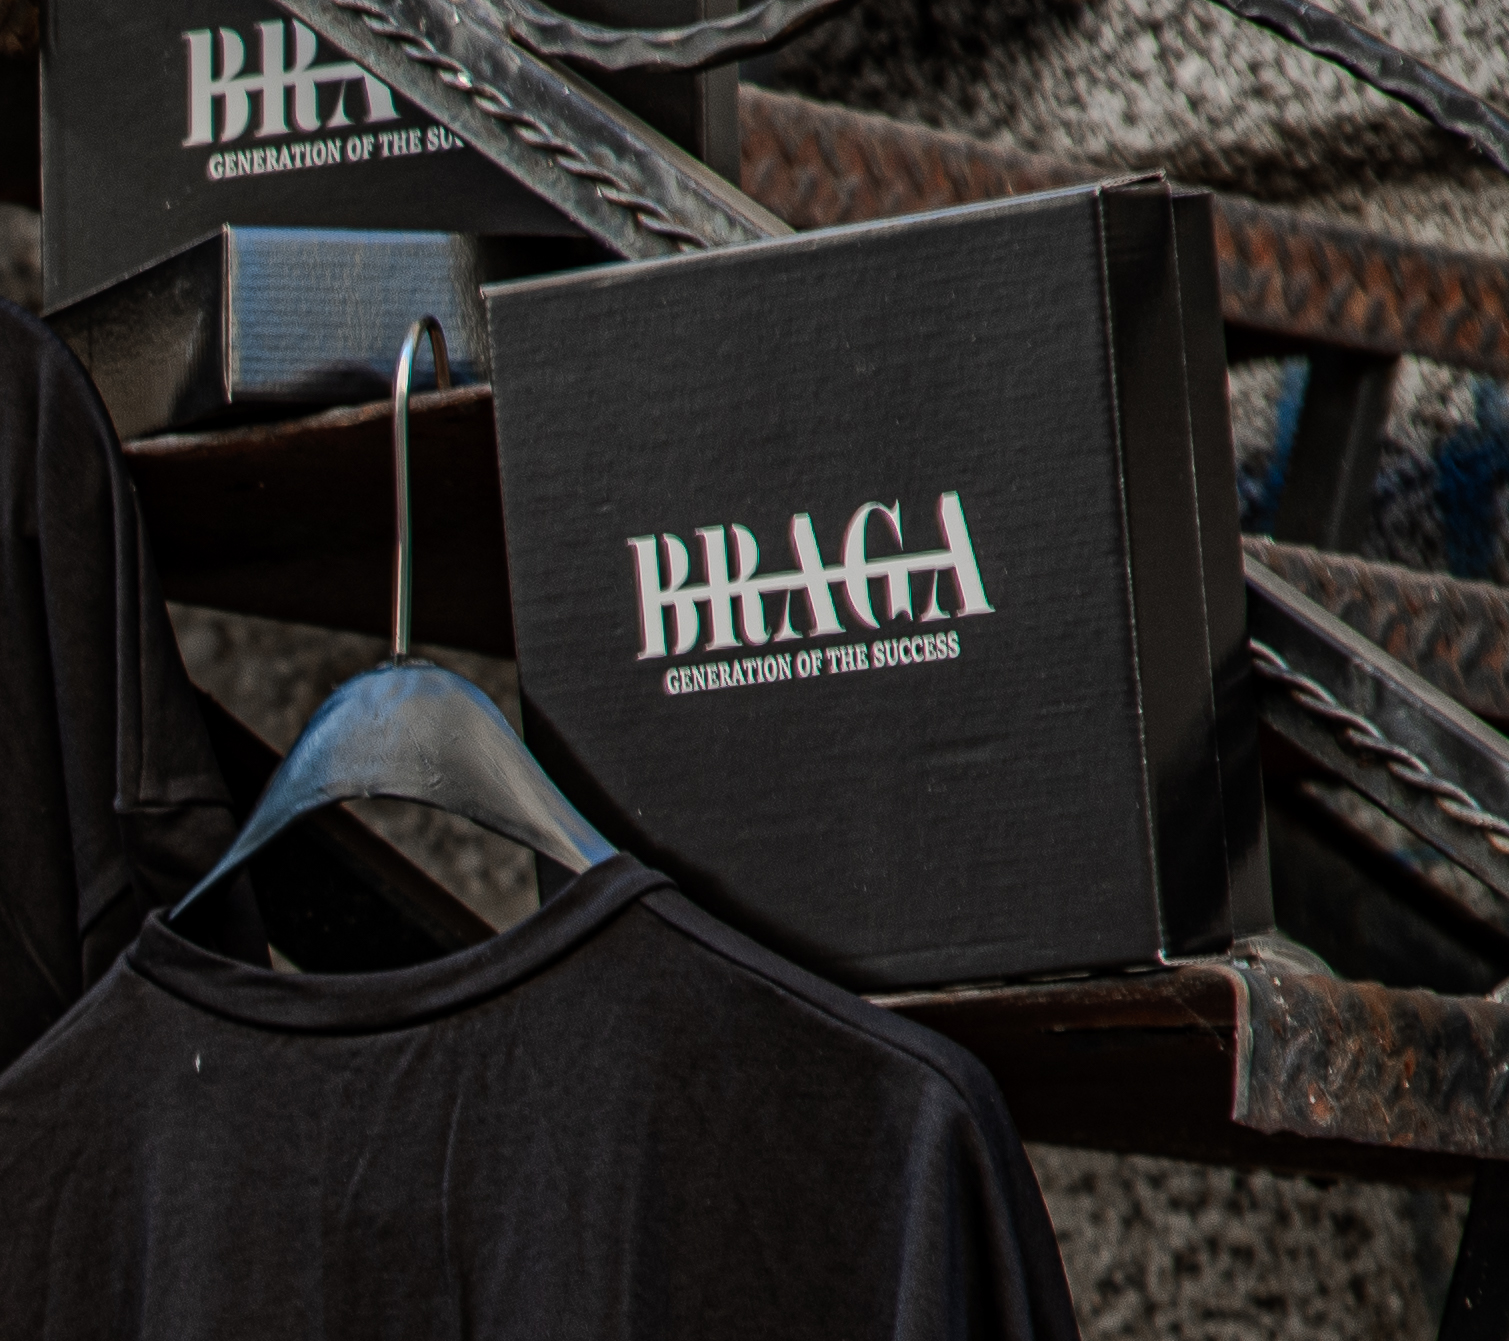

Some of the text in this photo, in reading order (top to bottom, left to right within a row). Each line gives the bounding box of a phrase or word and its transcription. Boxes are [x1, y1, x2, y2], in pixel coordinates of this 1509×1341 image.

[207, 141, 344, 182] GENERATION
[346, 134, 374, 163] OF
[376, 127, 423, 159] THE
[626, 489, 996, 660] BRAGA
[663, 629, 961, 696] GENERATION OF THE SUCCESS
